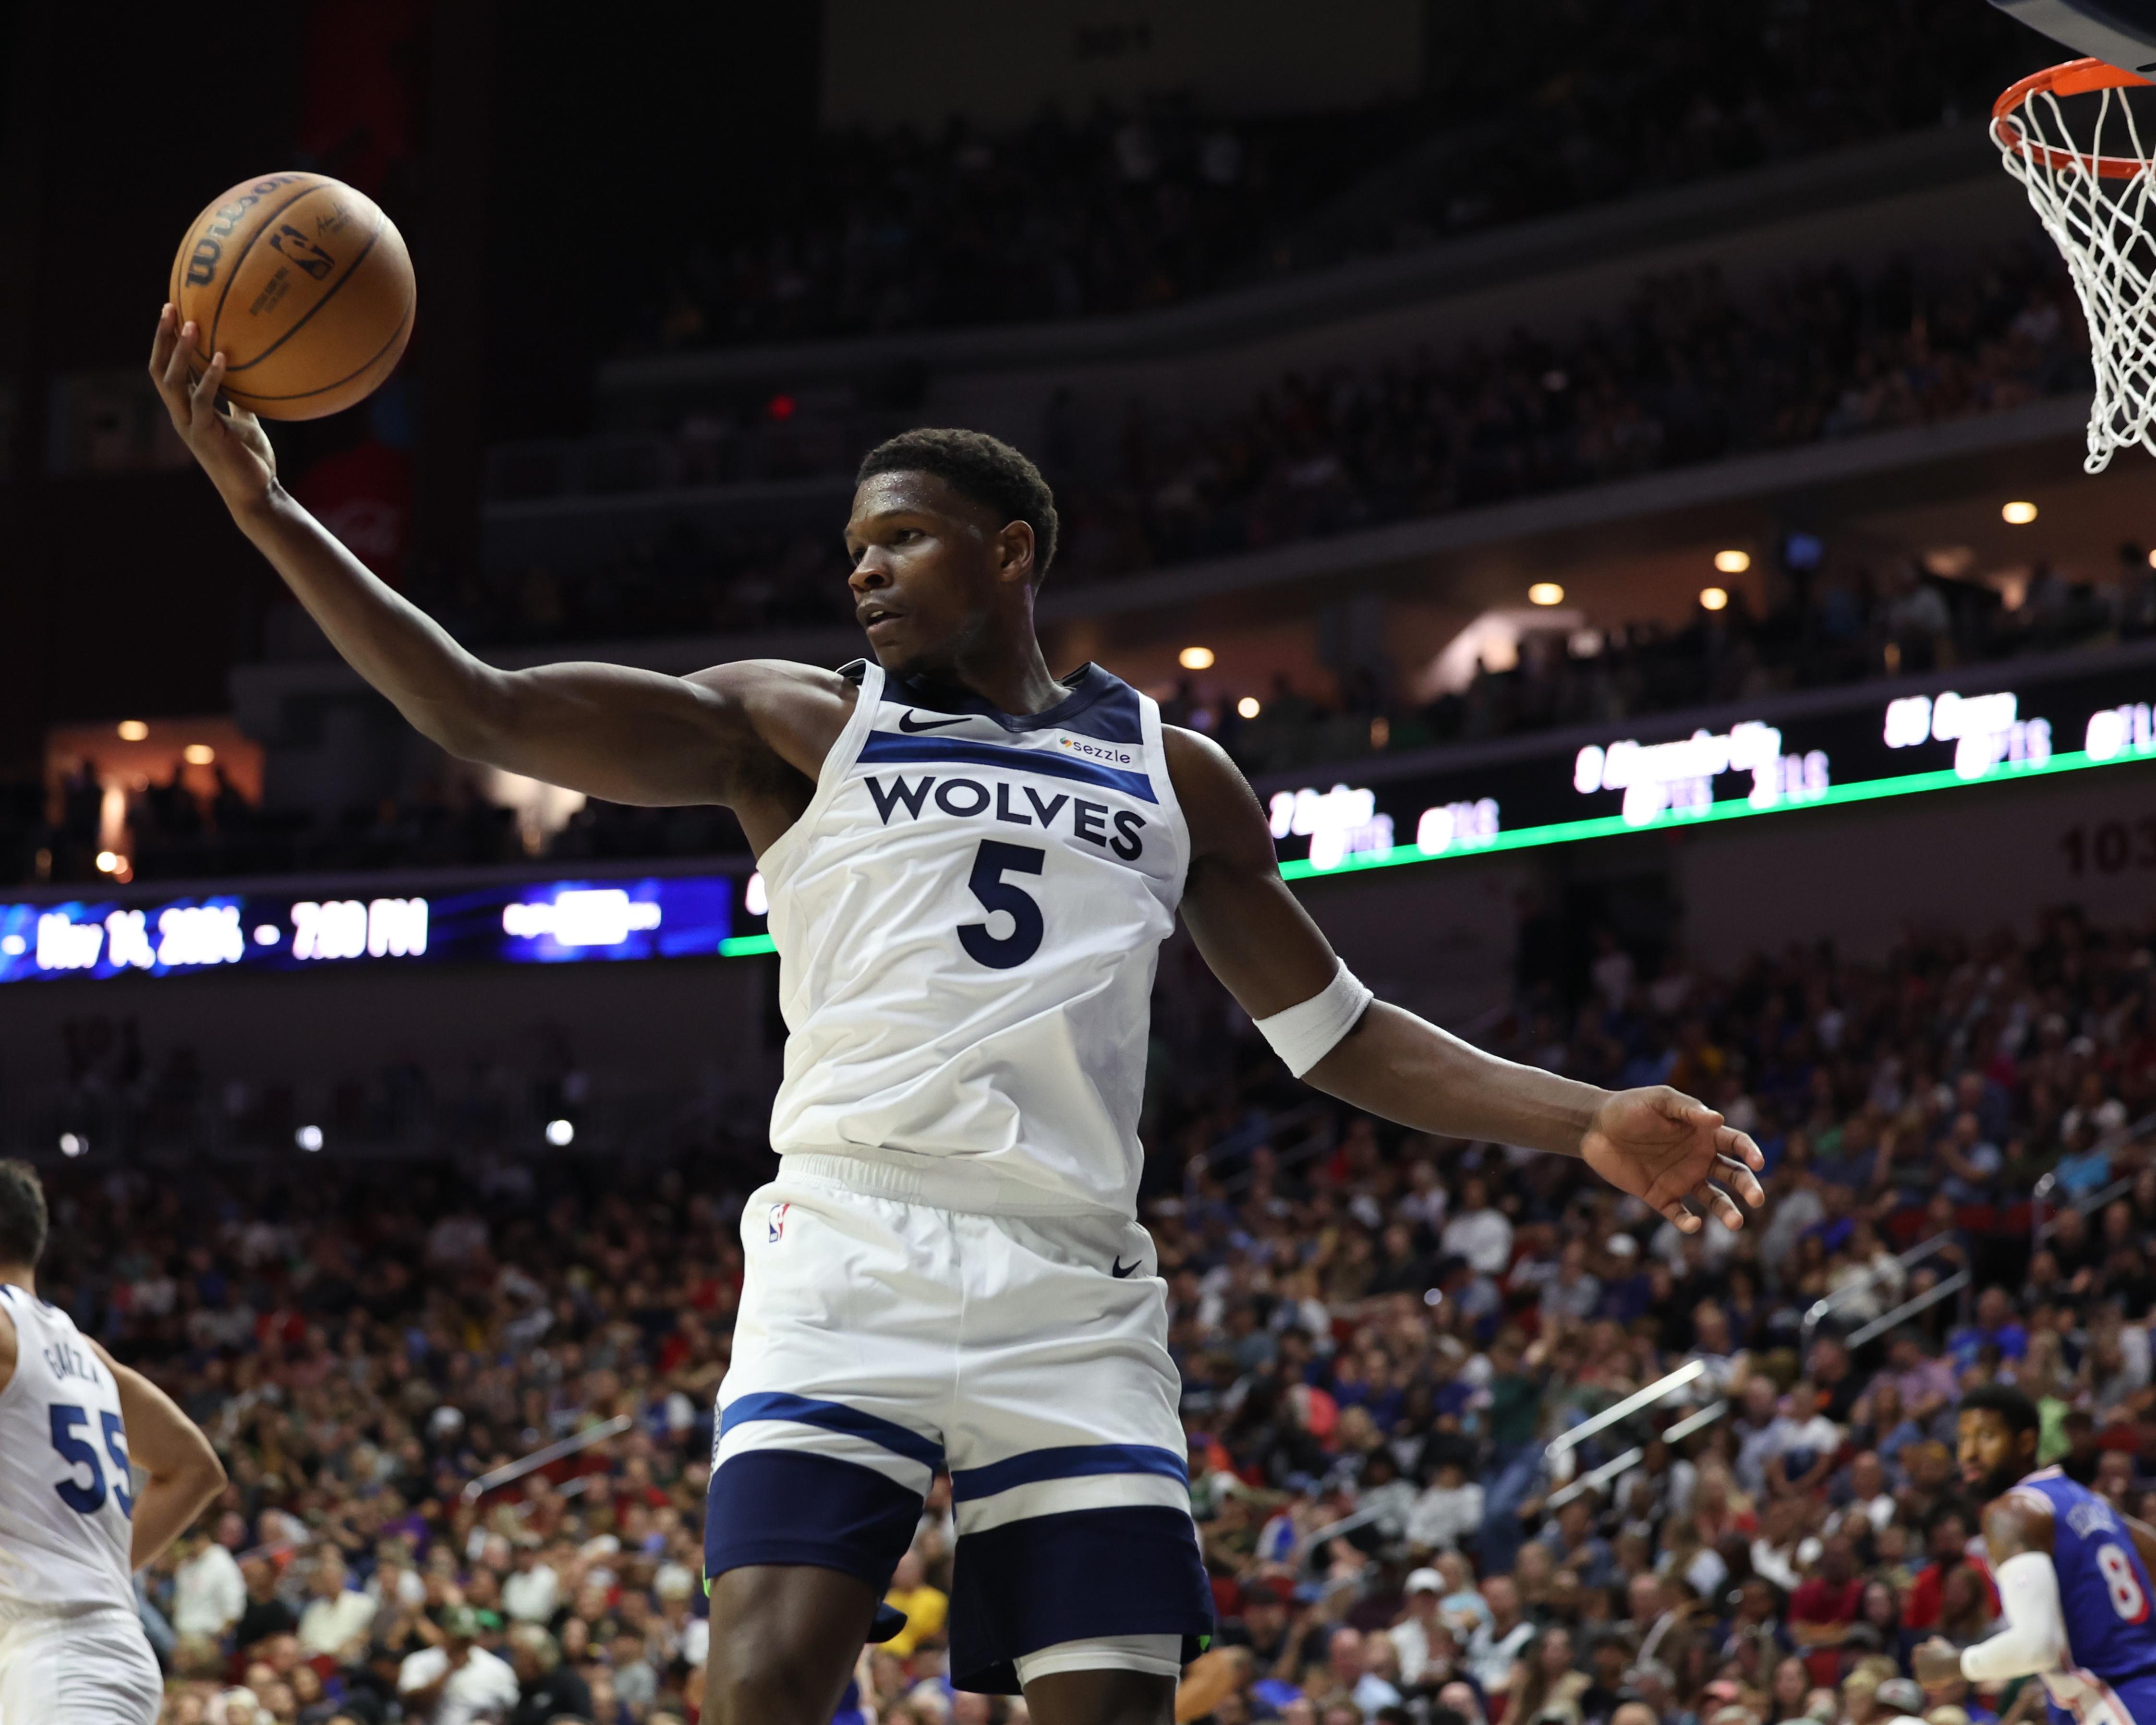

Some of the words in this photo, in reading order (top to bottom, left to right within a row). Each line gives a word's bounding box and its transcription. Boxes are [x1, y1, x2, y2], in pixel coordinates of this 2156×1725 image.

[1073, 742, 1130, 763] sezzle
[864, 775, 1147, 861] WOLVES
[957, 839, 1045, 969] 5
[49, 1404, 132, 1520] 55
[2096, 1543, 2150, 1625] 8
